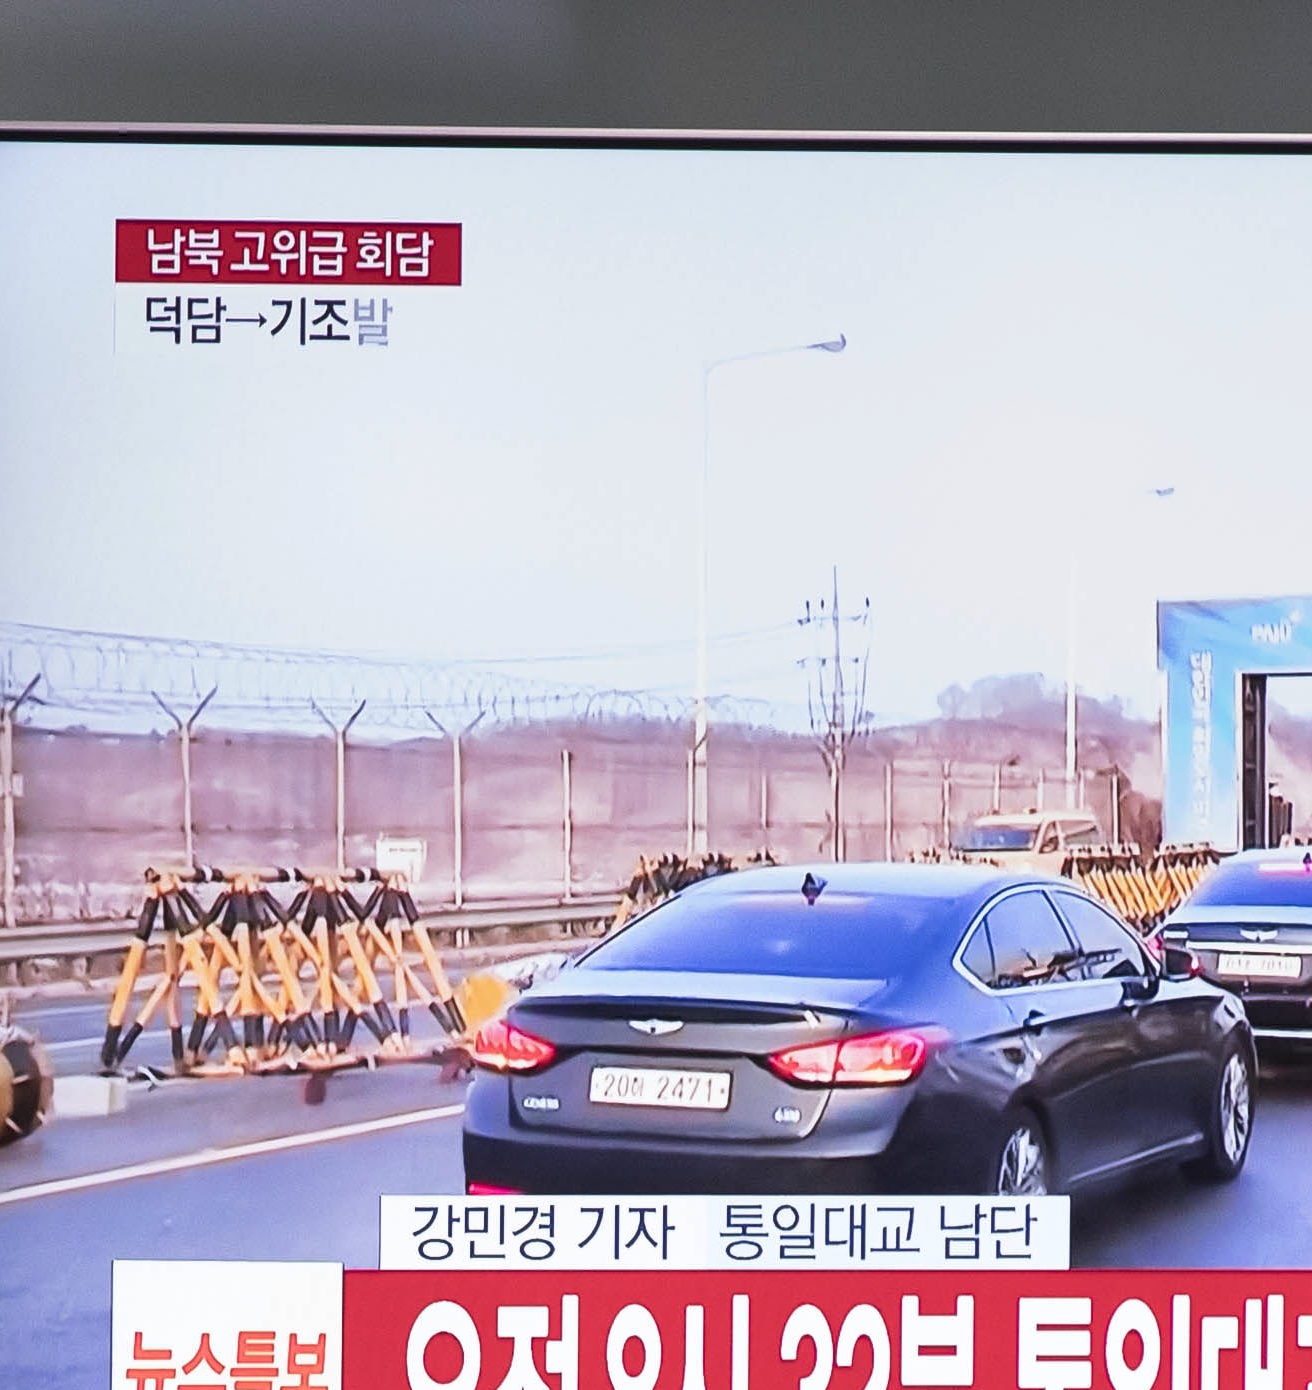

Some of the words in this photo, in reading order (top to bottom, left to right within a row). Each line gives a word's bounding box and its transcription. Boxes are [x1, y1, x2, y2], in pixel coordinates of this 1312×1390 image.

[147, 228, 224, 276] 남북
[230, 229, 348, 277] 고위급
[356, 230, 435, 278] 회담
[411, 1203, 558, 1262] 강민경
[577, 1203, 676, 1262] 기자
[719, 1203, 922, 1262] 통일대교
[938, 1203, 1039, 1263] 남단
